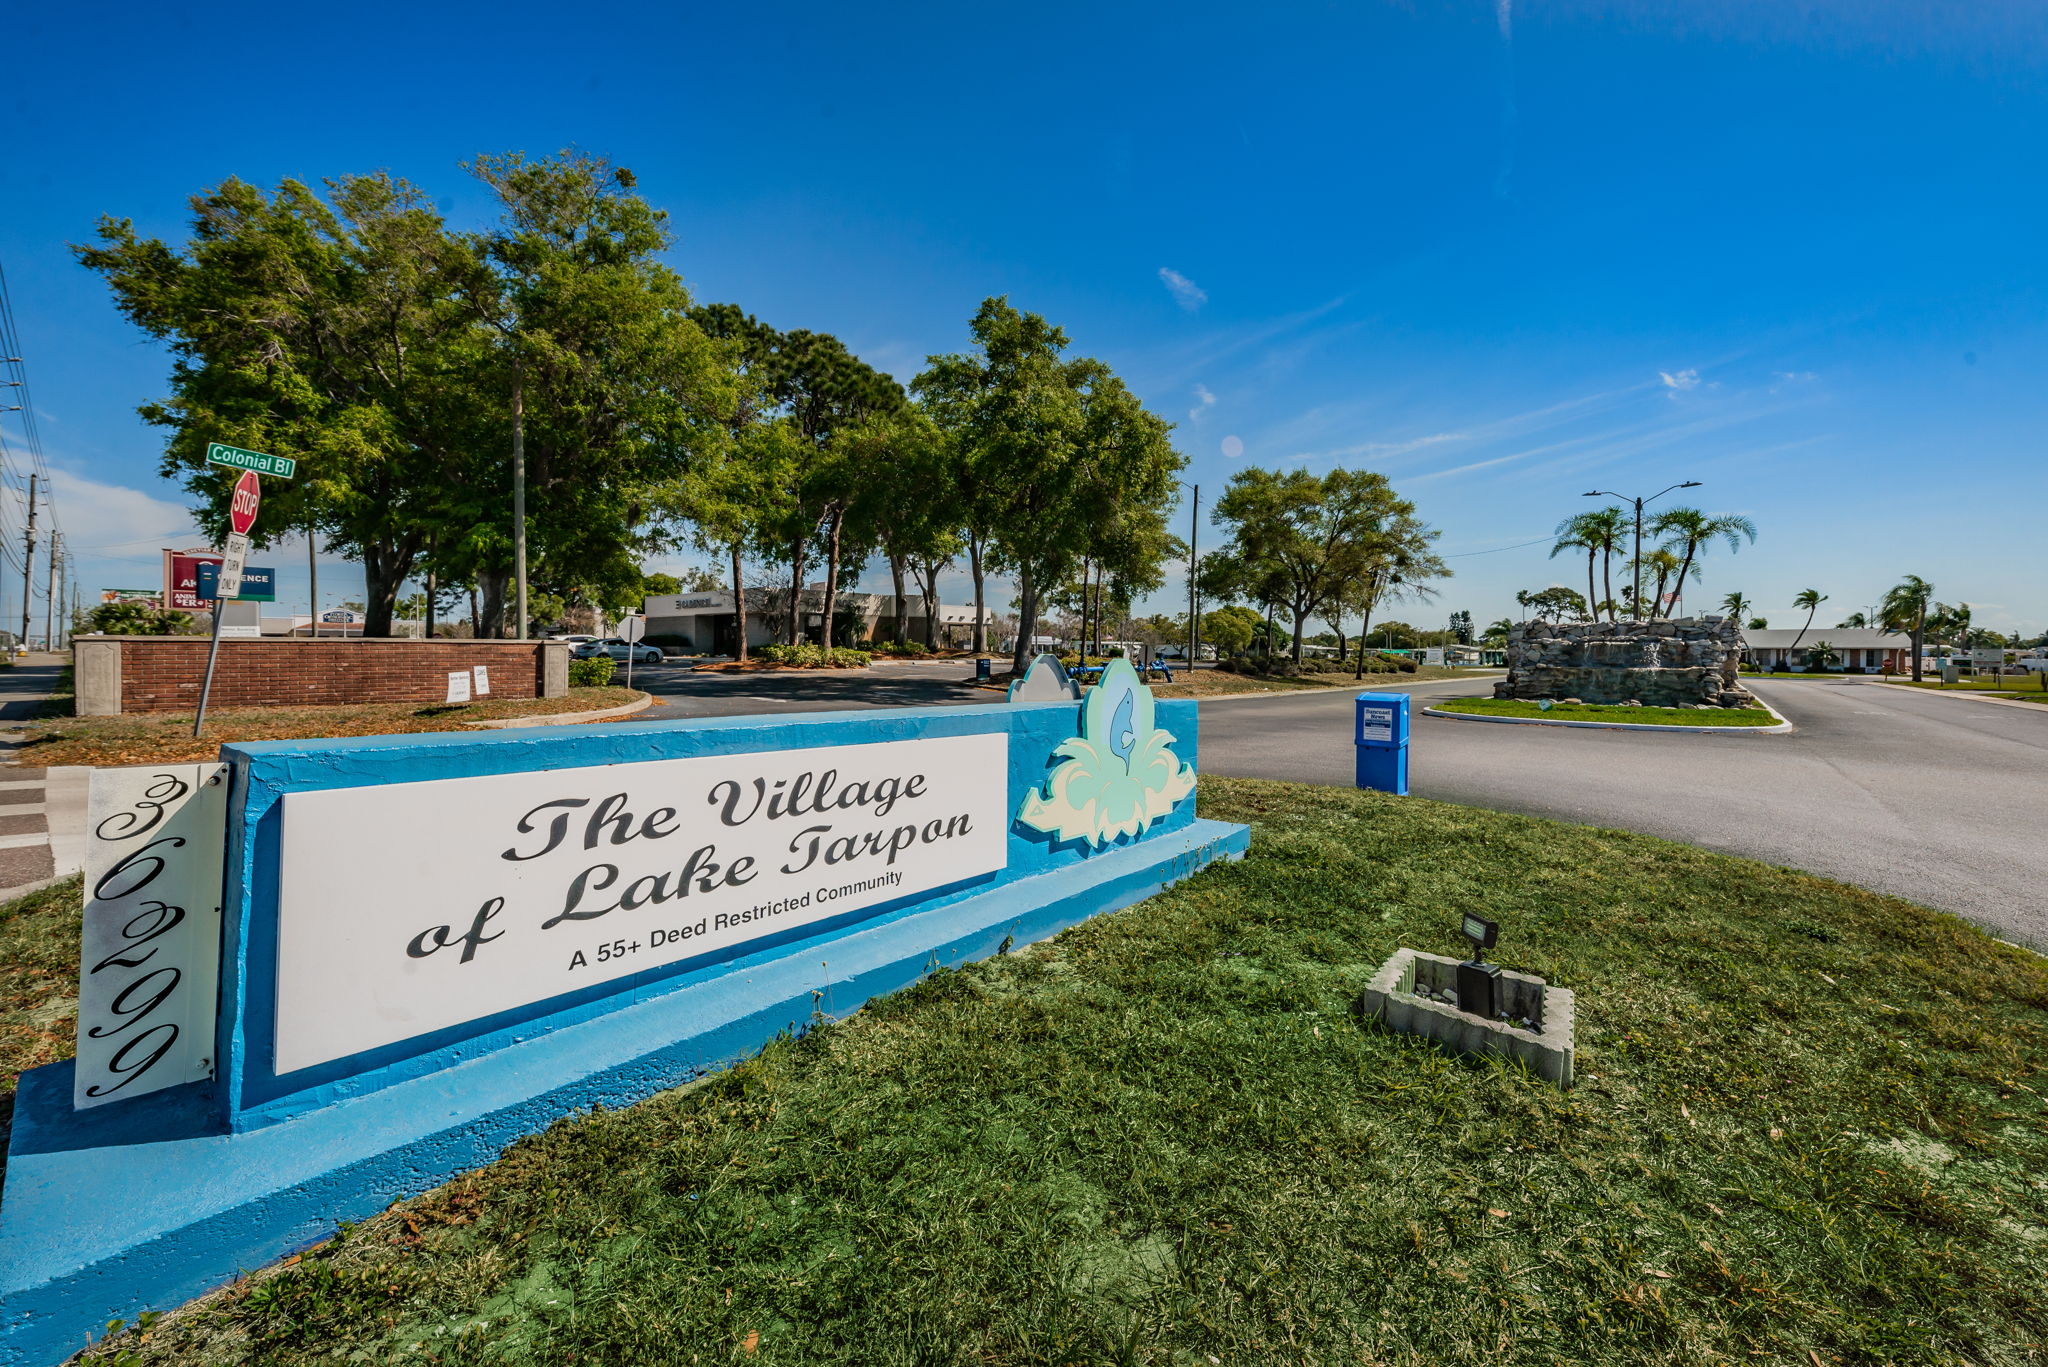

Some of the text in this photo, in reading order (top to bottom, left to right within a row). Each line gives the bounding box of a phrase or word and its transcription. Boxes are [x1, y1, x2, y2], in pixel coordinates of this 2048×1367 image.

[212, 446, 290, 474] Colonial Bl
[234, 488, 257, 516] STOP
[230, 540, 245, 554] RIGHT
[227, 558, 239, 571] TURN
[221, 577, 236, 590] ONLY
[182, 599, 197, 607] ER
[501, 768, 928, 861] The Village
[406, 813, 973, 965] of Lake Tarpon
[568, 871, 903, 971] A 55+ Deed Restricted Community
[86, 774, 189, 1097] 36299
